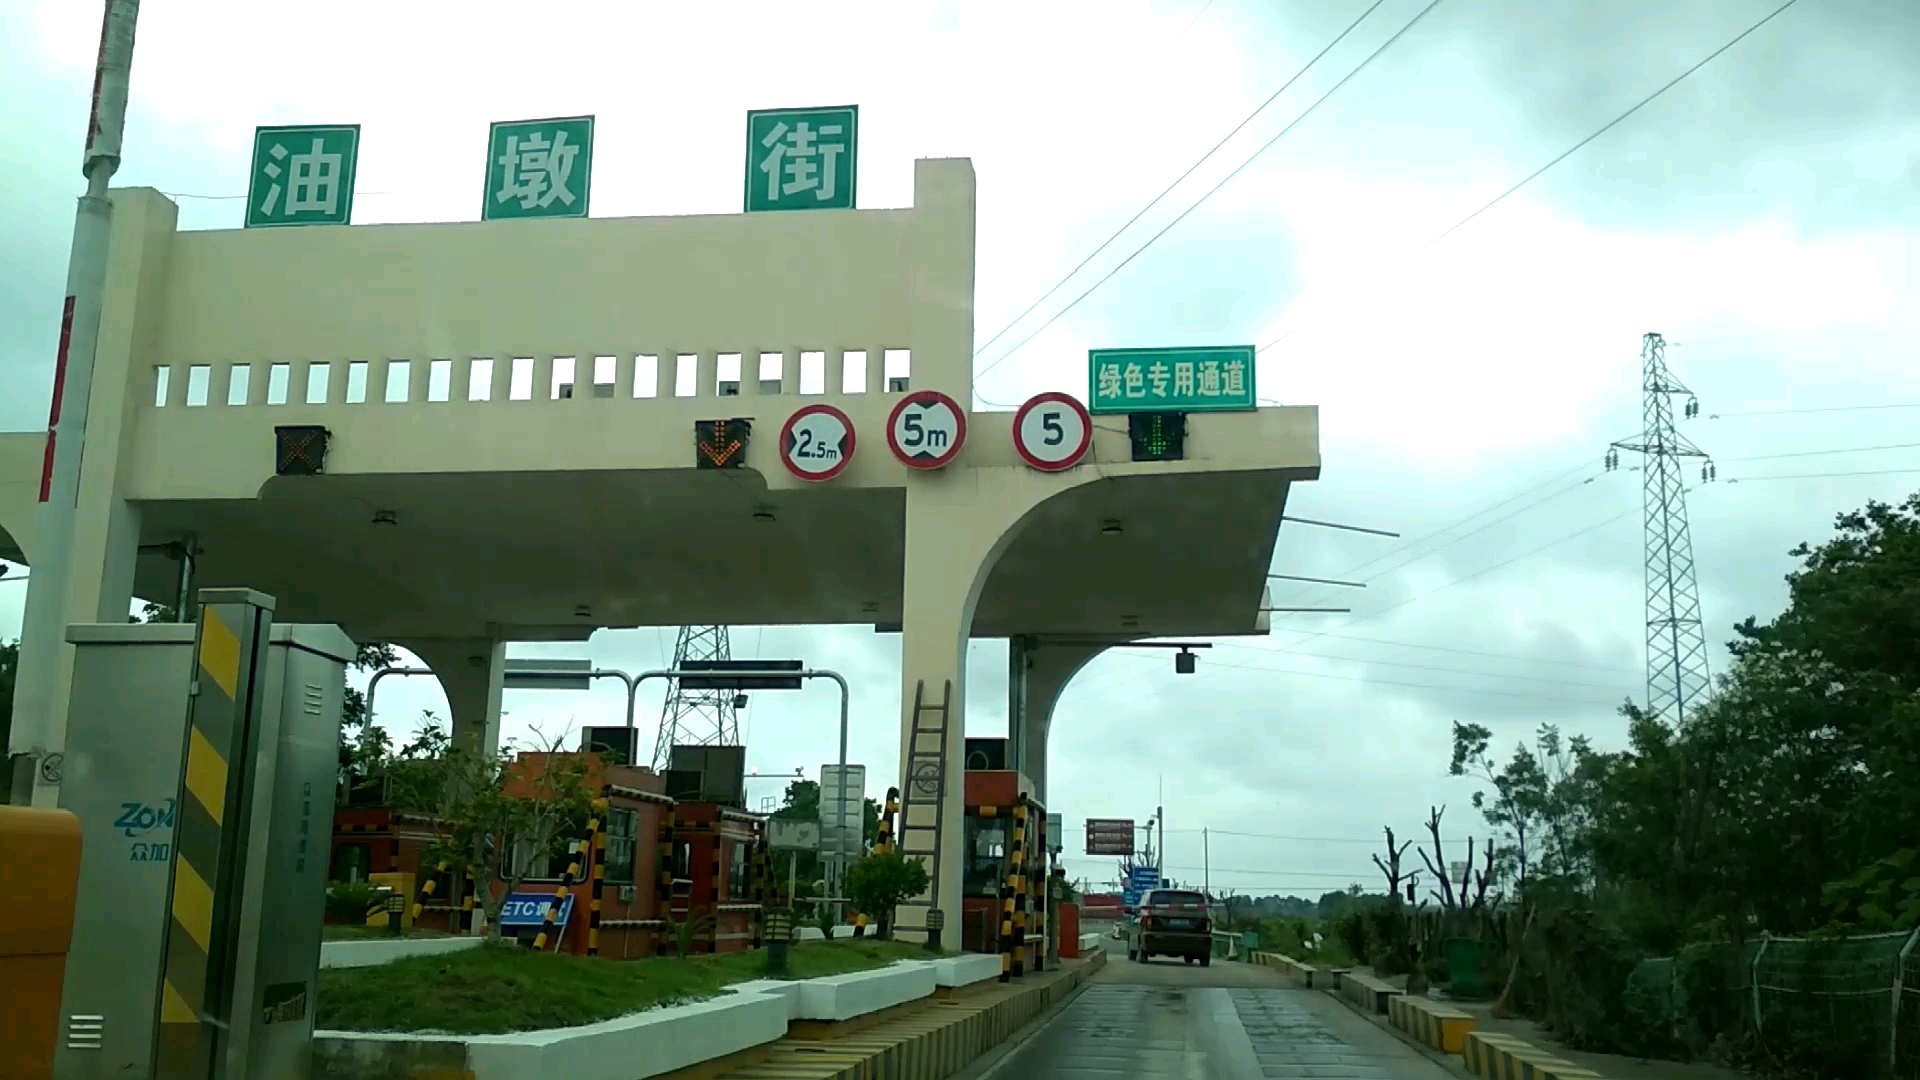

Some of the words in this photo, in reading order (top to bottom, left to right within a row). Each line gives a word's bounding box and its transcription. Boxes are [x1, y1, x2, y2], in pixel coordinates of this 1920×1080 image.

[260, 138, 342, 217] 油
[496, 129, 580, 210] 墩
[760, 121, 845, 201] 街
[1098, 359, 1246, 400] 绿色专用通道
[796, 428, 838, 460] 2.5m
[903, 413, 947, 448] 5m
[1042, 411, 1064, 446] 5
